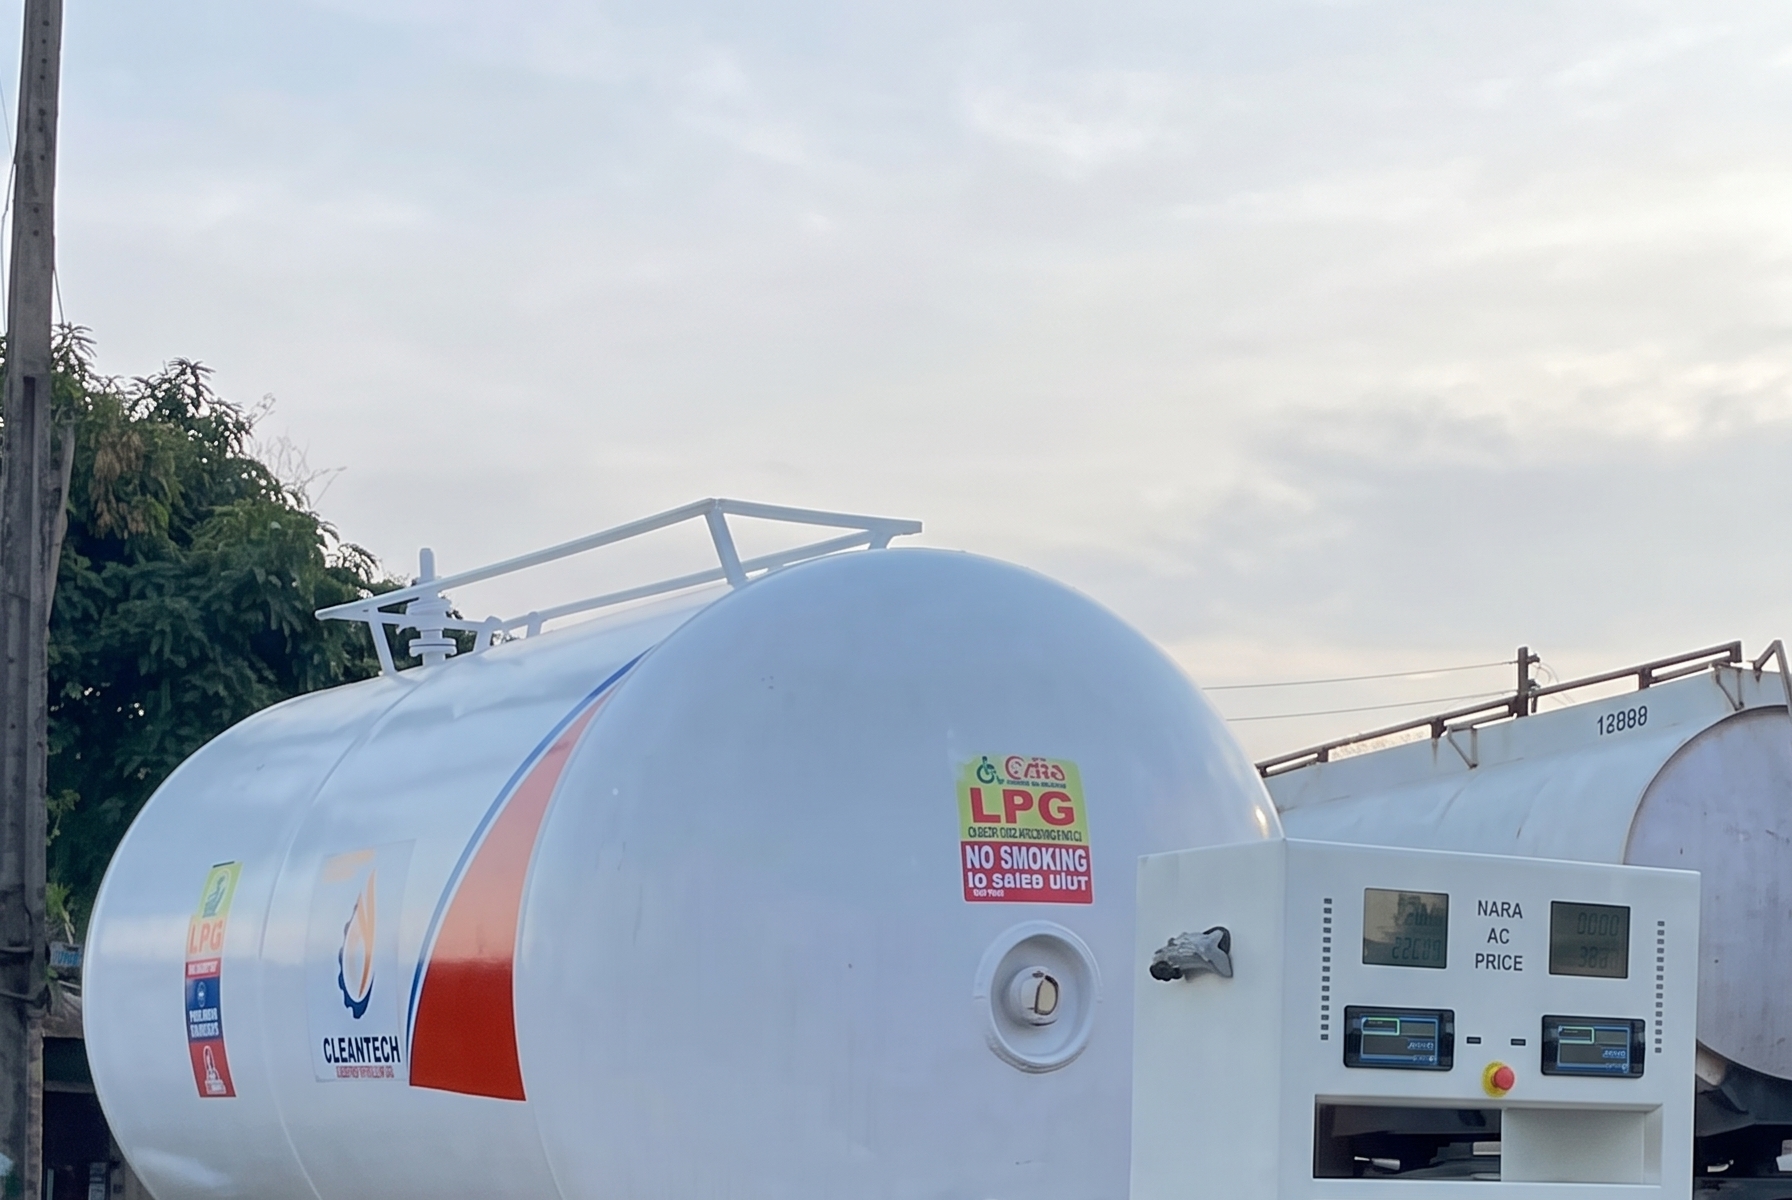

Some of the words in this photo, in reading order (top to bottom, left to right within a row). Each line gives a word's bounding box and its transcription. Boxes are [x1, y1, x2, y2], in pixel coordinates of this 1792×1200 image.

[970, 787, 1075, 826] LPG
[965, 845, 994, 869] NO
[1000, 845, 1087, 872] SMOKING
[1478, 900, 1523, 919] NARA
[189, 919, 223, 954] LPG
[1487, 928, 1509, 944] AC
[1475, 953, 1523, 971] PRICE
[323, 1035, 401, 1063] CLEANTECH
